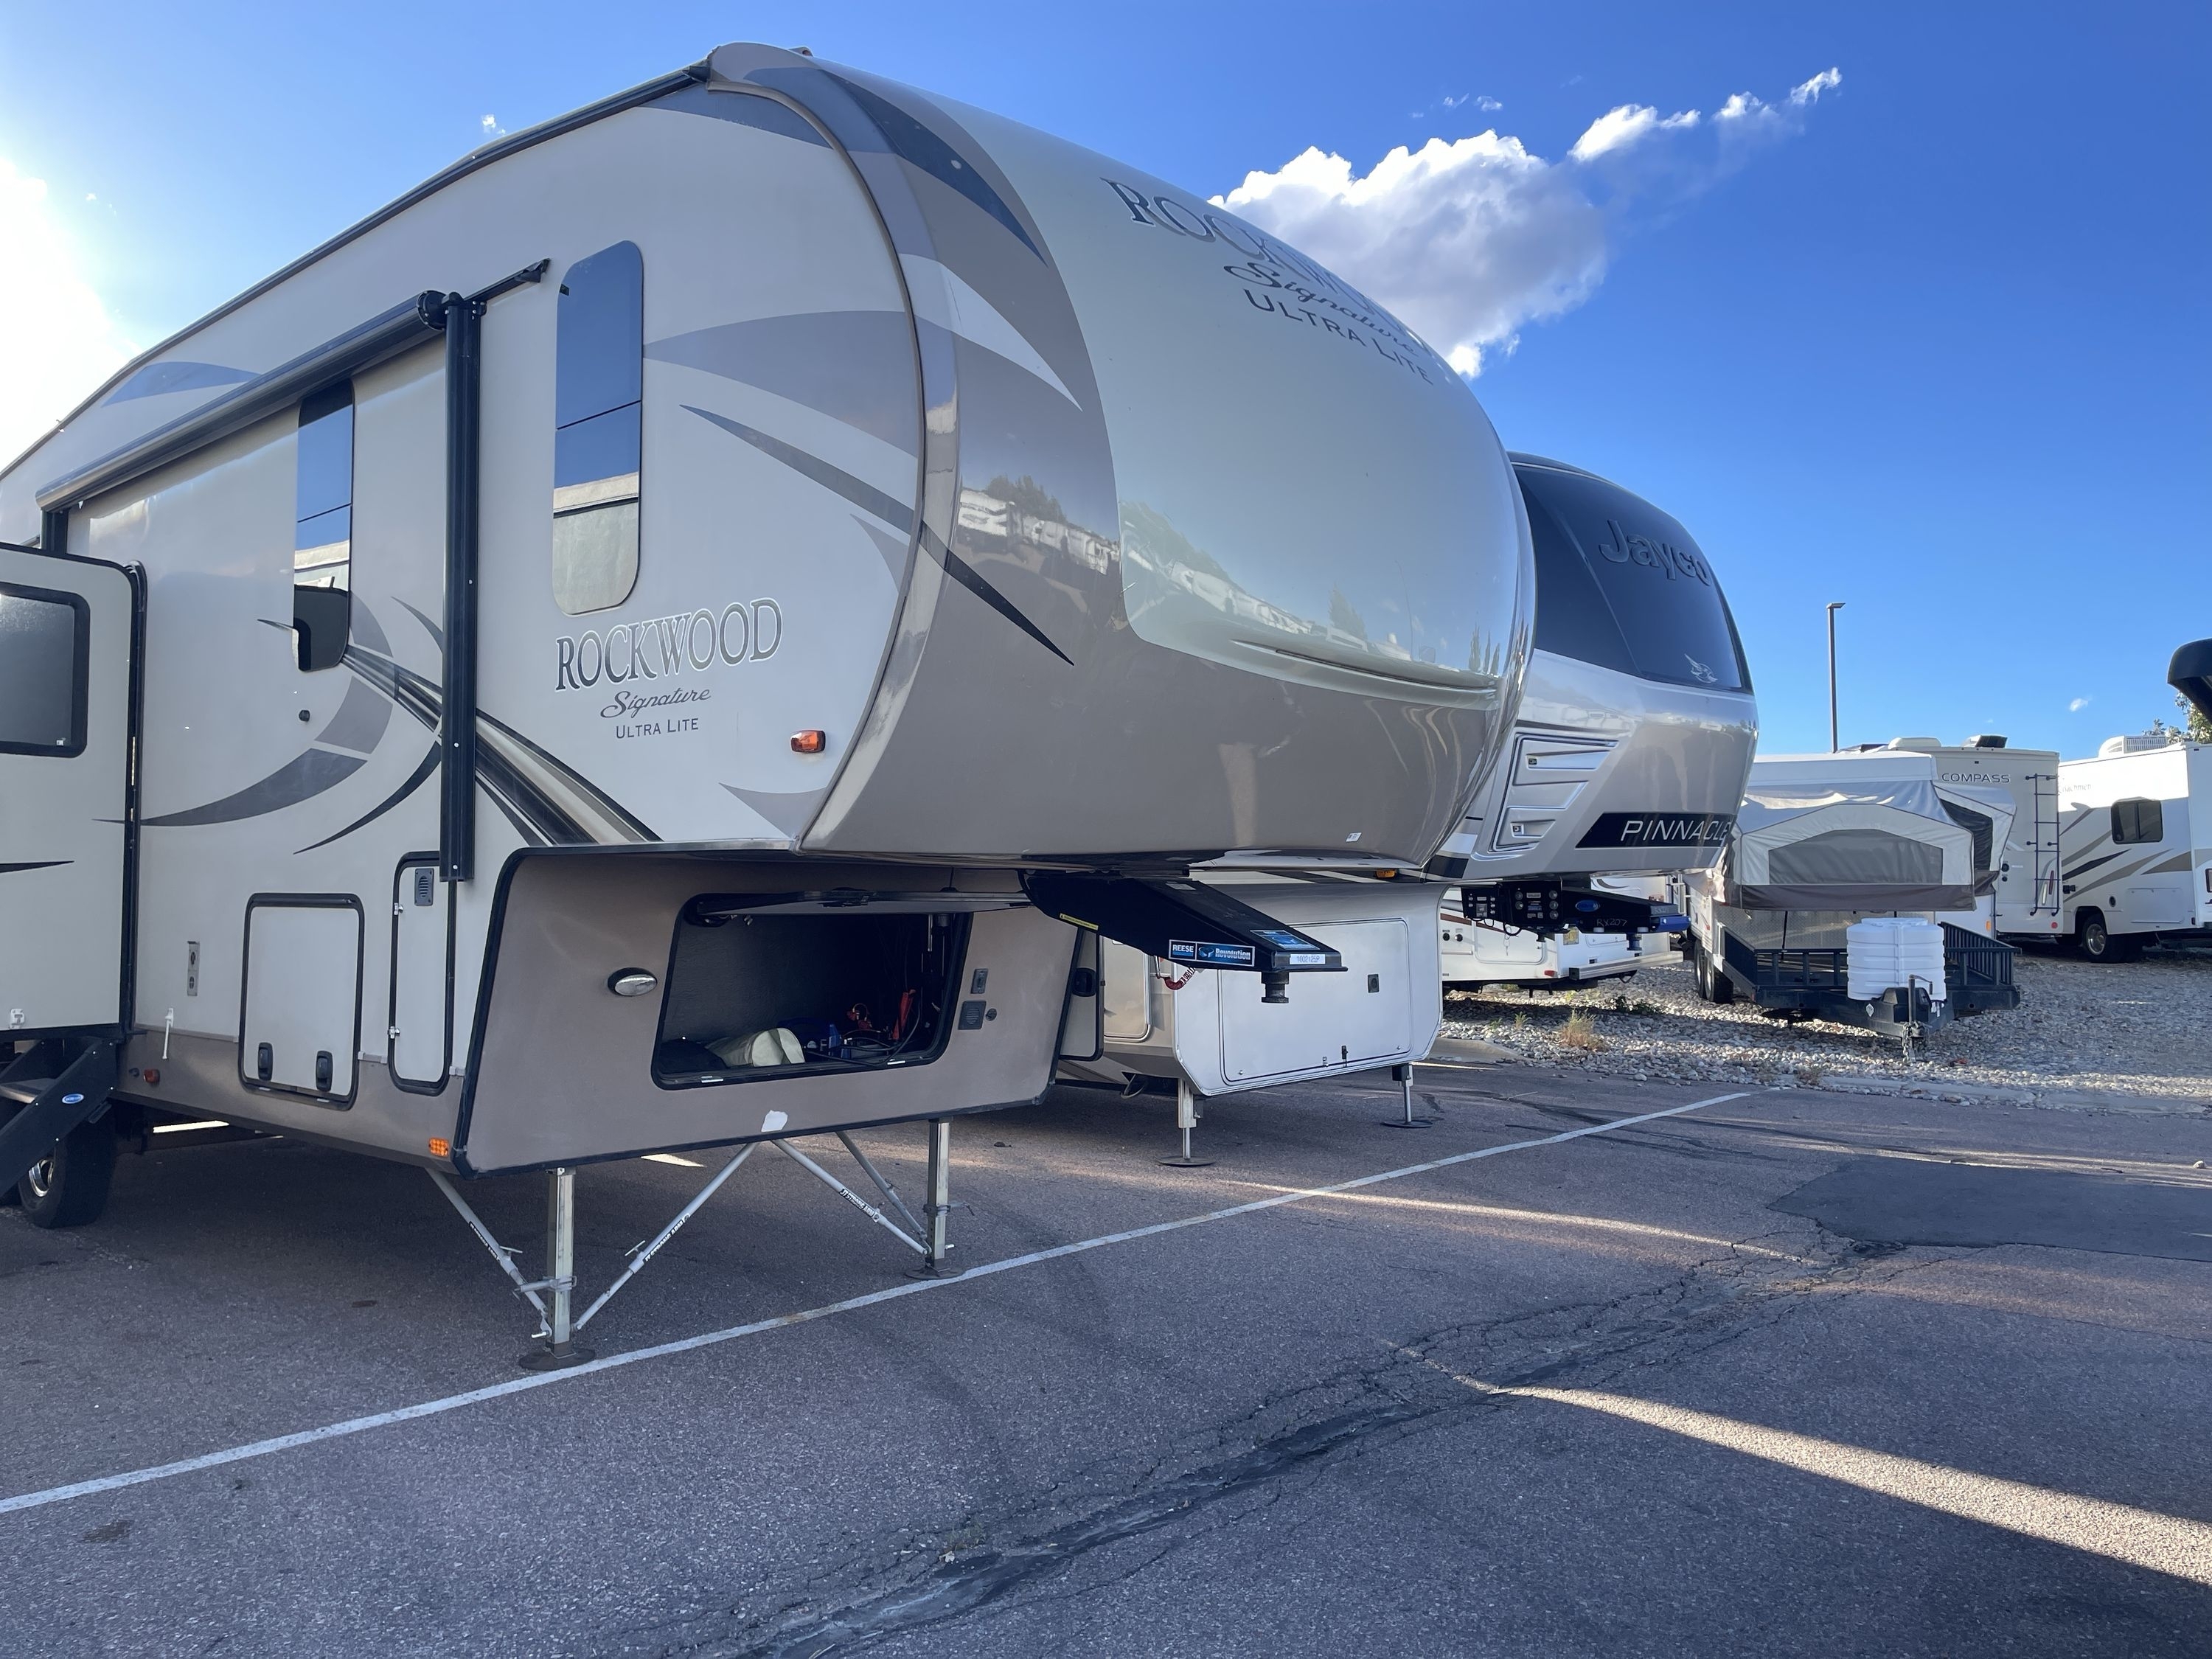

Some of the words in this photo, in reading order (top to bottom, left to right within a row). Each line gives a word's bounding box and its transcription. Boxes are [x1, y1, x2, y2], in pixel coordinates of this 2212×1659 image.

[1223, 262, 1419, 357] Signature
[1243, 288, 1367, 347] ULTRA
[1371, 338, 1434, 386] LITE
[1599, 519, 1712, 586] Jayco
[554, 597, 784, 692] ROCKWOOD
[600, 687, 712, 718] Signature
[616, 722, 661, 739] ULTRA
[667, 717, 699, 733] LITE
[1941, 773, 2011, 783] COMPASS
[1620, 820, 1732, 841] PINNACLE
[1596, 918, 1628, 927] RX207
[1172, 944, 1194, 953] REESE
[1215, 947, 1251, 960] Revolution
